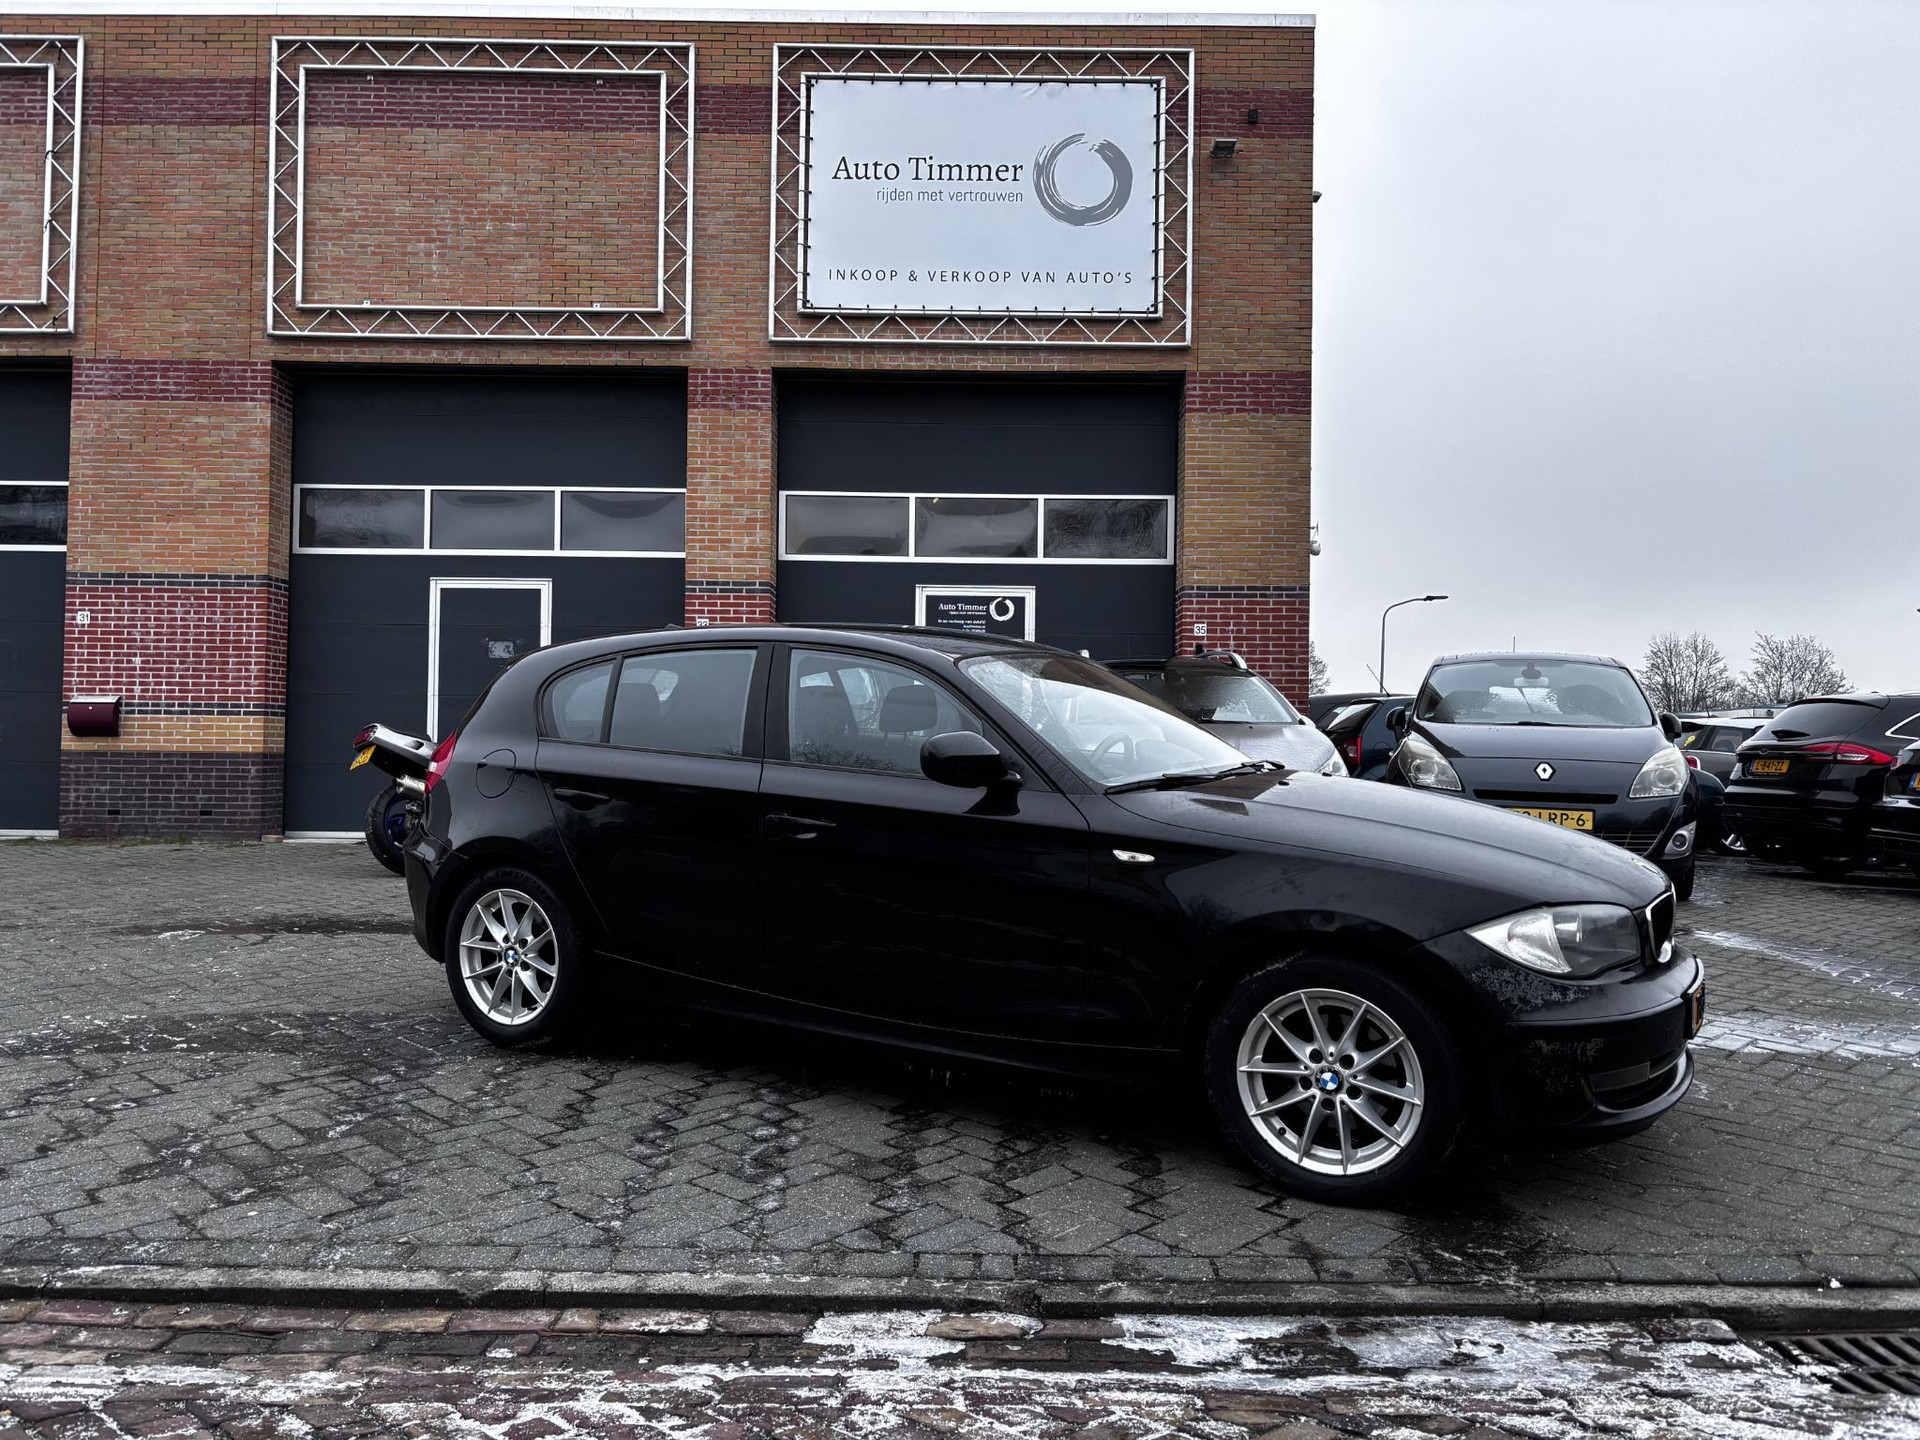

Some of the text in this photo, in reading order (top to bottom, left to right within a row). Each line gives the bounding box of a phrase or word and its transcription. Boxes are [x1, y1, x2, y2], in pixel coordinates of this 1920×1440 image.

[831, 156, 1023, 181] Auto Timmer
[876, 188, 1023, 204] rijden met vertrouwen
[829, 269, 1133, 284] INKOOP & VERKOOP VAN AUTO'S
[938, 603, 987, 611] Auto Timmer
[79, 613, 89, 622] 31
[1195, 625, 1206, 635] 35
[1513, 810, 1586, 827] -RP-6
